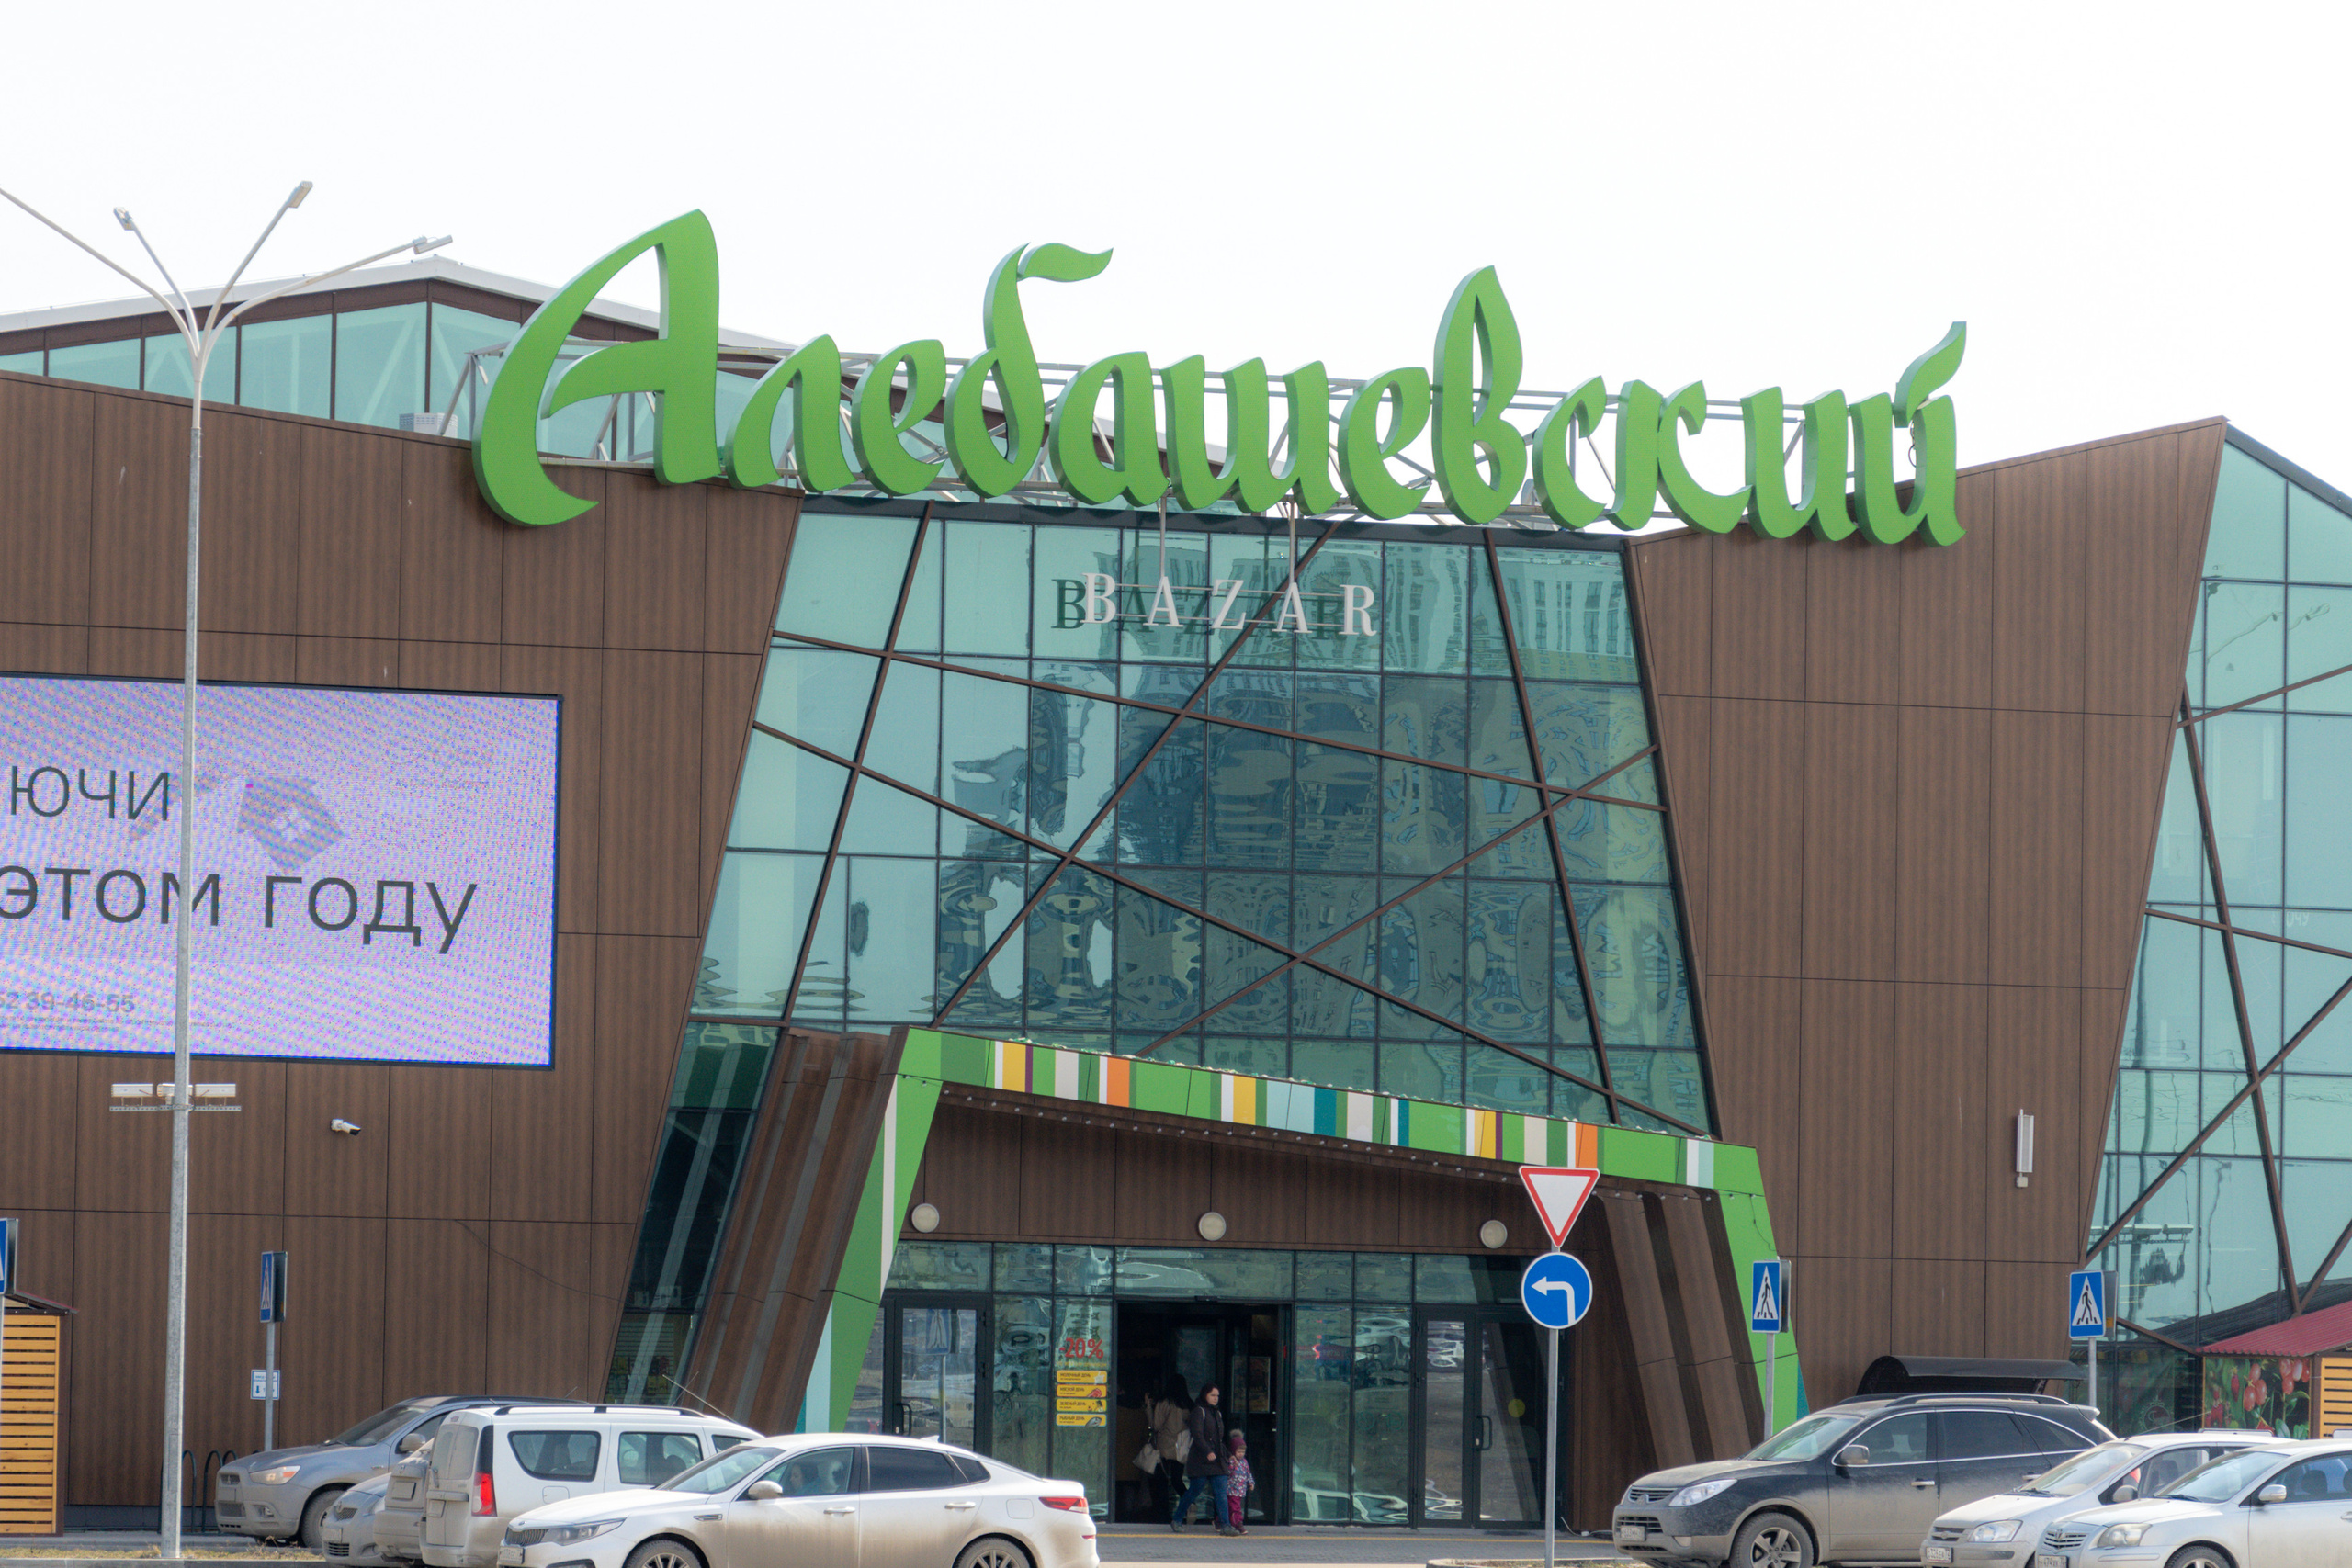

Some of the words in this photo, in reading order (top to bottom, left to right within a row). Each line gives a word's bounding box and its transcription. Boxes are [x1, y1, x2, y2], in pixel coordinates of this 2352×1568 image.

[471, 209, 1968, 547] Алебашевский
[1080, 572, 1378, 637] BAZAR
[26, 991, 135, 1012] 39-46-55
[1058, 1337, 1104, 1359] -20%
